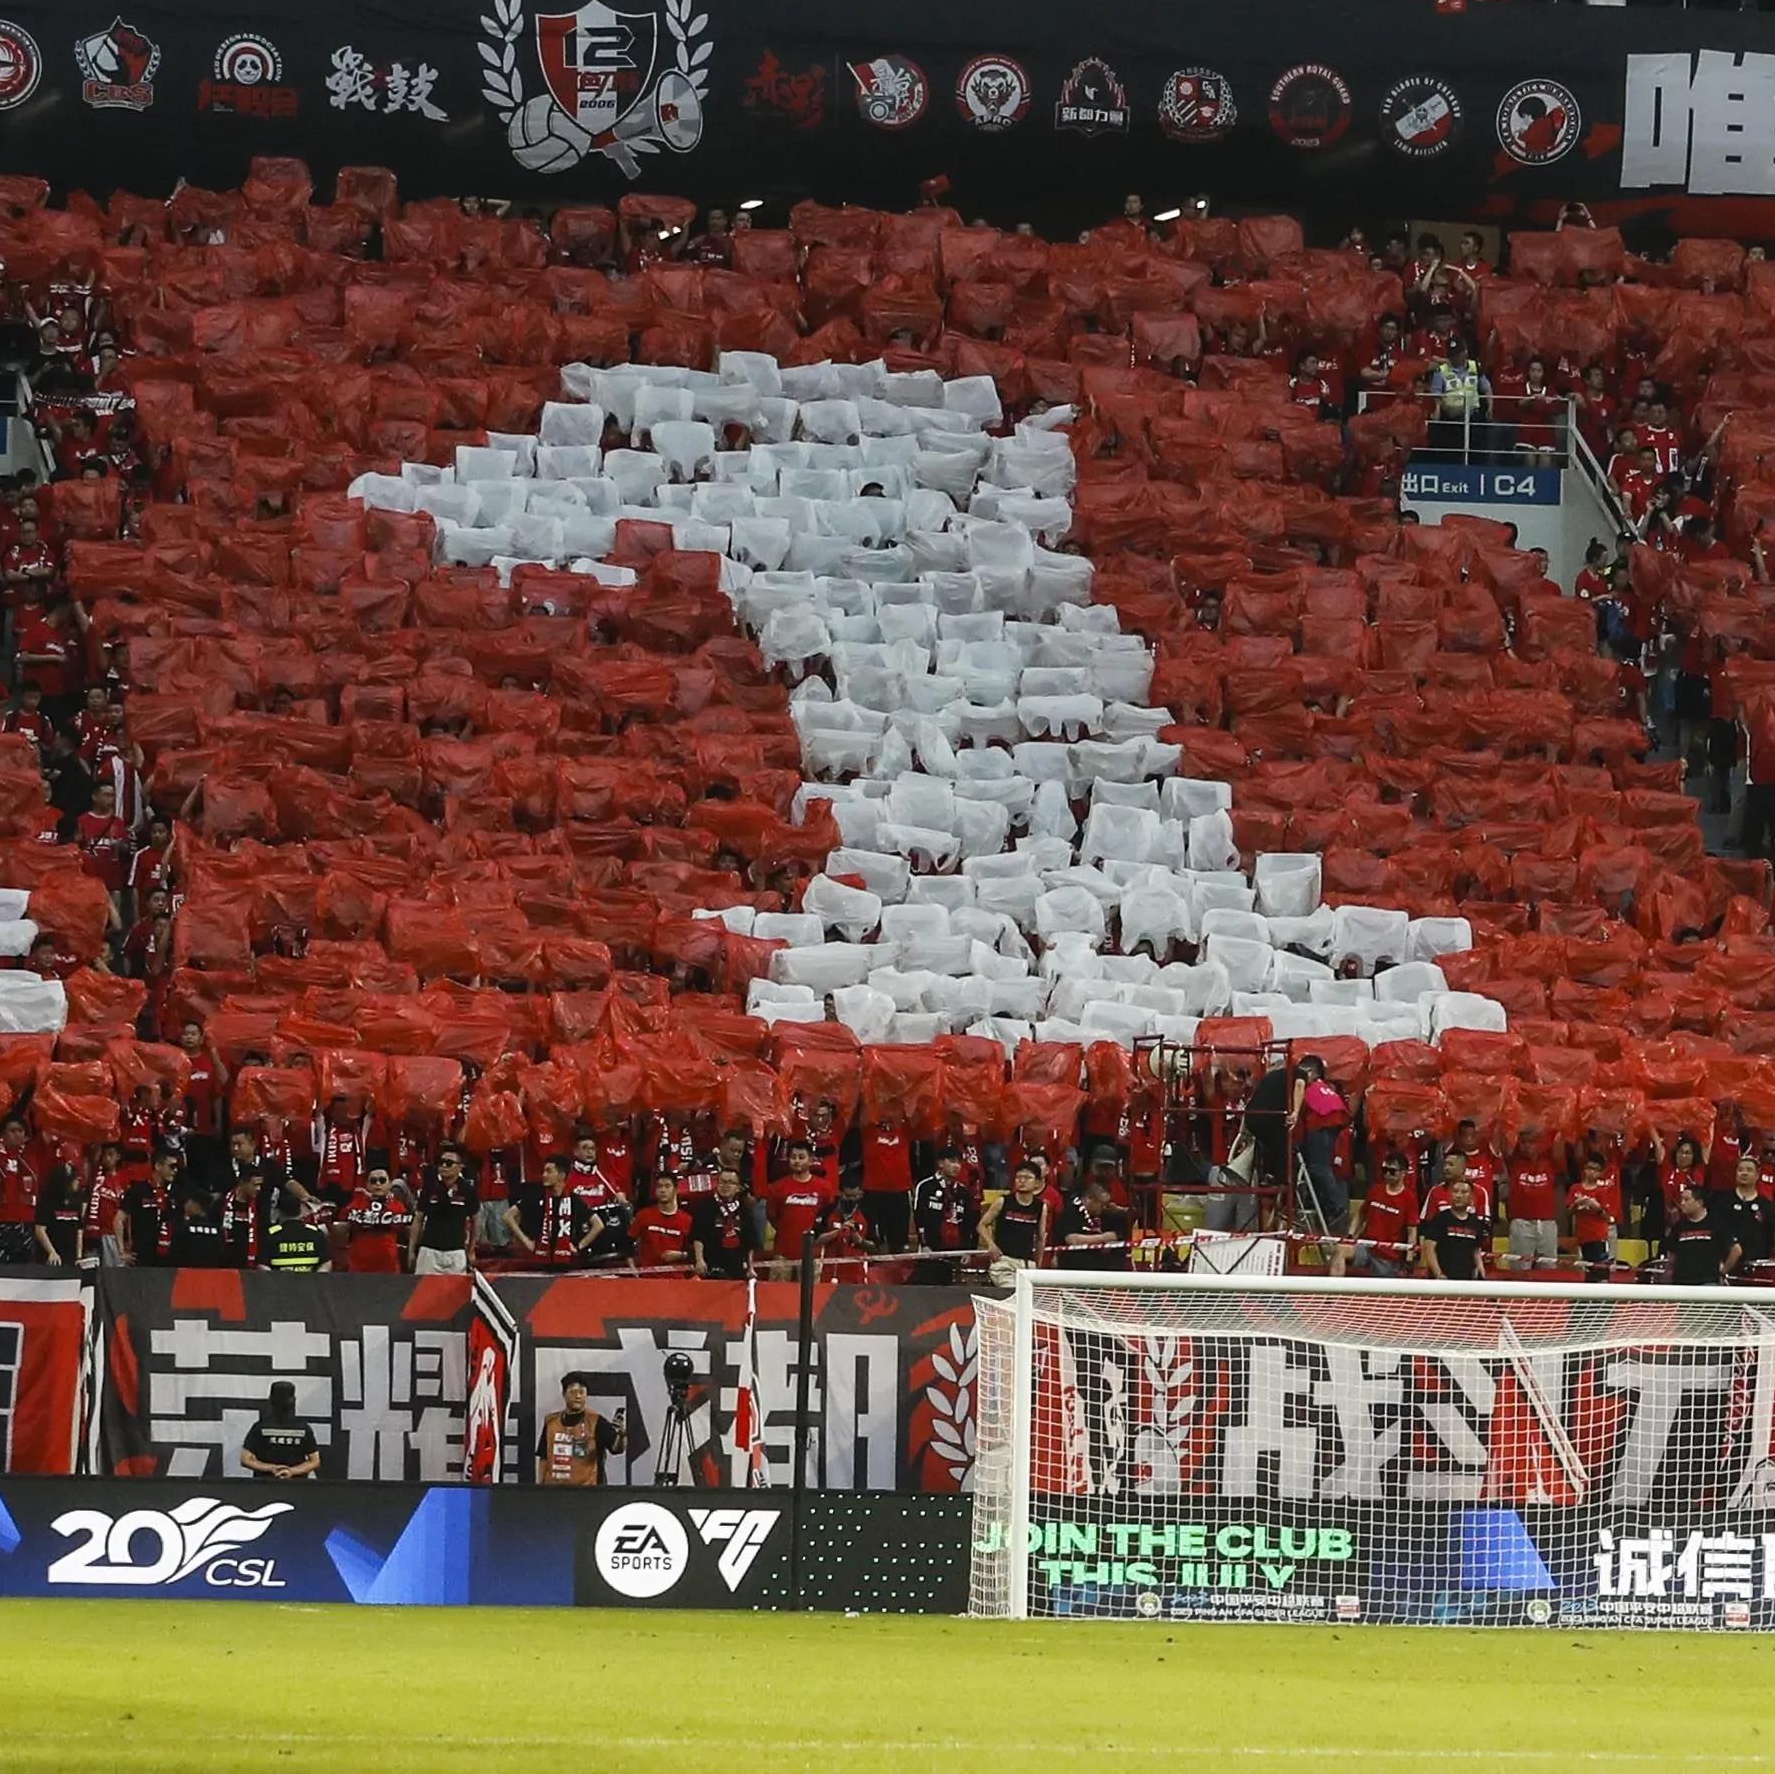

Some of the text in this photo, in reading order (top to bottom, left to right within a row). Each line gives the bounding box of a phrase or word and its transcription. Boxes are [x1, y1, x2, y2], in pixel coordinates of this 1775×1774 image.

[1271, 64, 1352, 106] SOUTHERN ROYAL GUARD
[578, 98, 616, 110] 2006
[1061, 106, 1124, 124] 新都力量
[1401, 472, 1537, 497] 出口 Exit C4
[47, 1508, 183, 1585] 20
[614, 1525, 663, 1554] EA
[1107, 1523, 1208, 1557] THE
[1216, 1525, 1354, 1561] CLUB
[204, 1558, 286, 1588] CSL
[609, 1555, 673, 1572] SPORTS
